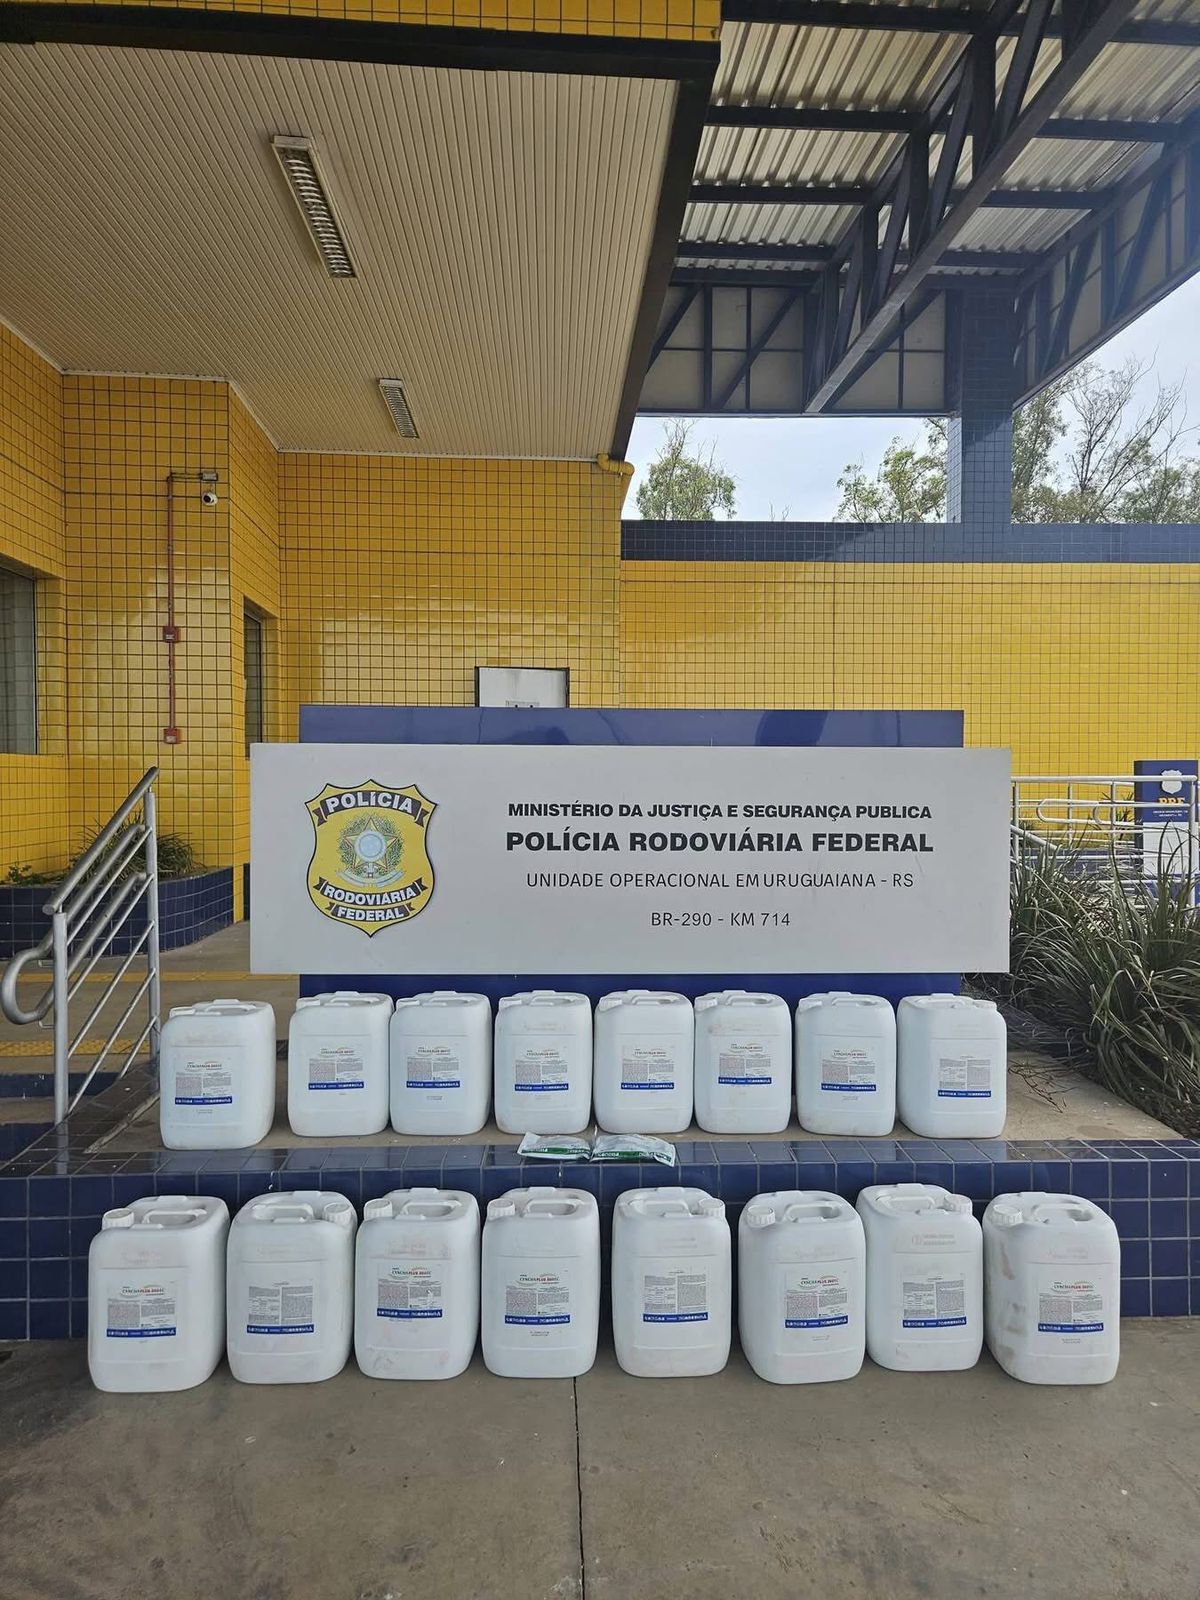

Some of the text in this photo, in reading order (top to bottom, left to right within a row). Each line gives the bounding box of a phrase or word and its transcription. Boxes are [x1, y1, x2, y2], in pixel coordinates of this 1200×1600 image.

[325, 792, 413, 814] POLÍCIA
[508, 800, 933, 822] MINISTÉRIO DA JUSTIÇA E SEGURANÇA PUBLICA
[506, 826, 934, 853] POLÍCIA RODOVIÁRIA FEDERAL
[527, 872, 604, 888] UNIDADE
[609, 873, 730, 888] OPERACIONAL
[893, 873, 914, 888] RS
[323, 886, 417, 906] RODOVIÁRIA
[336, 907, 404, 921] FEDERAL
[651, 912, 712, 927] BR-290
[730, 912, 755, 927] KM
[760, 912, 791, 927] 714
